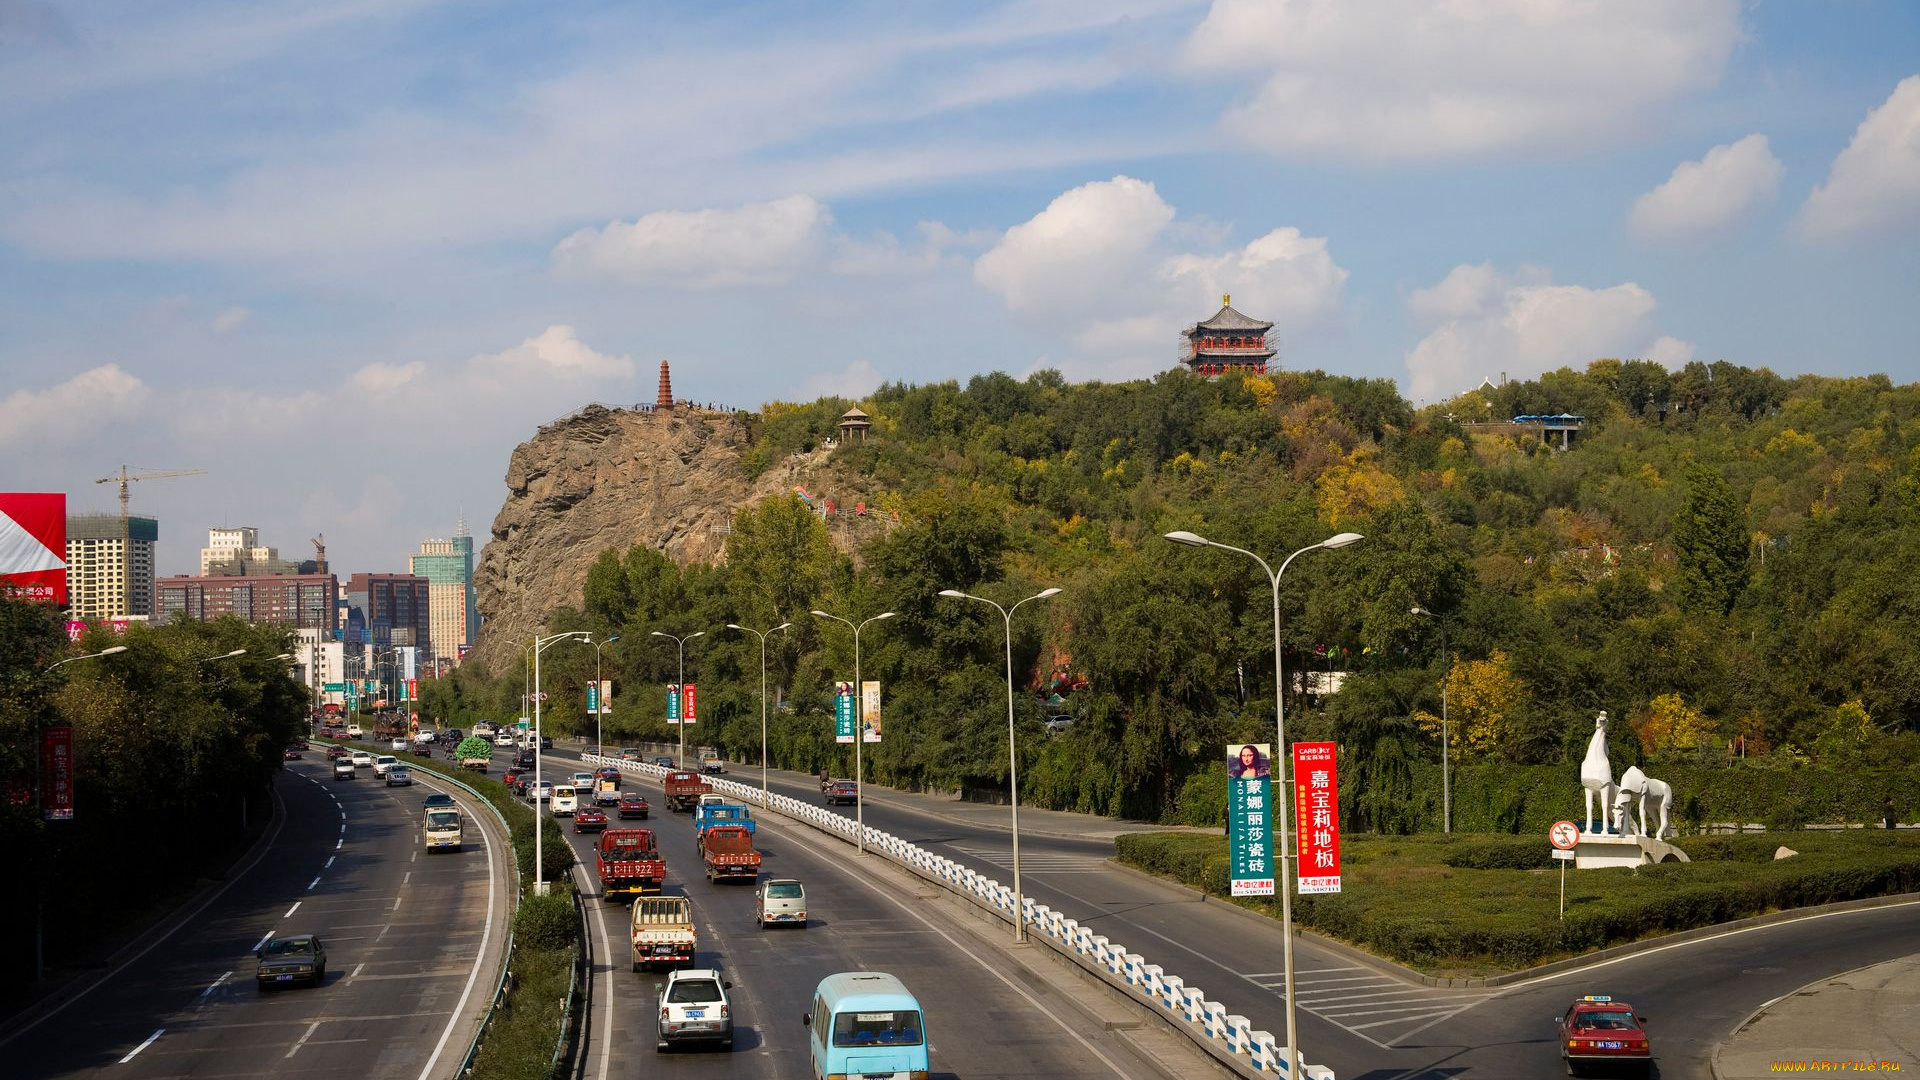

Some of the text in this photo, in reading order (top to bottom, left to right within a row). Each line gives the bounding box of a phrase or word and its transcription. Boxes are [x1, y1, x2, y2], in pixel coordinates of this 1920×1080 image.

[1246, 779, 1265, 873] 蒙娜丽莎瓷砖
[1311, 770, 1334, 869] 嘉宝莉地板
